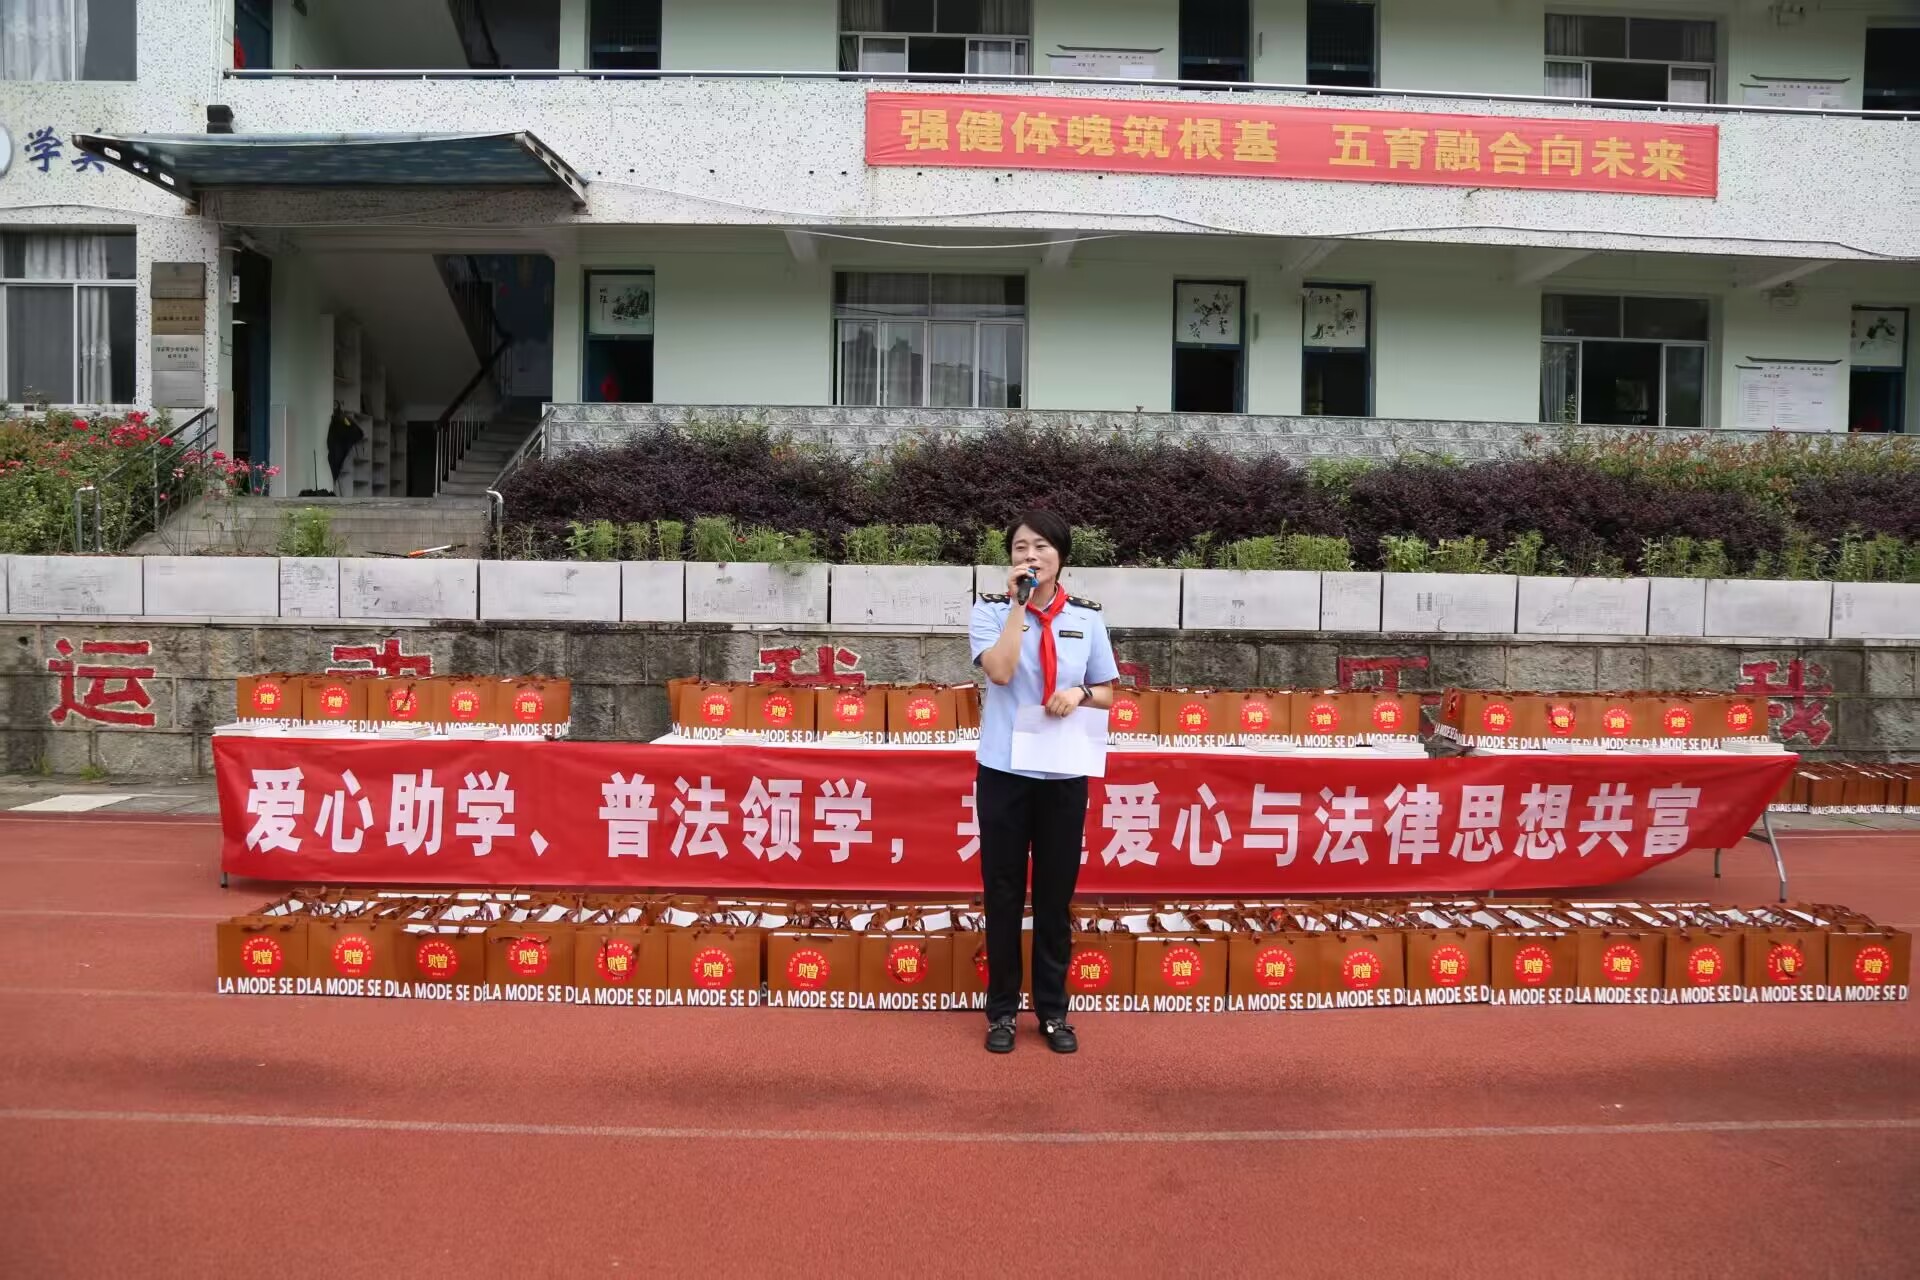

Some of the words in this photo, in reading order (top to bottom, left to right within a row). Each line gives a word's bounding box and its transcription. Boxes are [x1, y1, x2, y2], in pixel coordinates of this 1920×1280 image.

[900, 109, 1279, 163] 强健体魄筑根基
[1328, 124, 1687, 181] 五育融合向未来
[48, 638, 156, 728] 运
[511, 723, 539, 736] MODE
[541, 724, 553, 736] SE
[680, 726, 691, 739] LA
[693, 727, 723, 740] MODE
[791, 730, 803, 742] SE
[888, 732, 901, 744] LA
[903, 731, 933, 744] MODE
[935, 731, 946, 744] SE
[1159, 734, 1171, 747] LA
[1173, 734, 1203, 747] MODE
[1204, 735, 1216, 747] SE
[1225, 733, 1236, 746] LA
[1304, 735, 1332, 748] MODE
[1334, 735, 1345, 748] SE
[1463, 734, 1475, 747] LA
[1477, 735, 1505, 749] MODE
[1508, 737, 1519, 750] SE
[1528, 737, 1540, 750] LA
[1689, 738, 1699, 751] SE
[1708, 737, 1720, 750] LA
[252, 949, 272, 965] 赠
[343, 949, 363, 965] 赠
[428, 953, 448, 969] 赠
[518, 949, 539, 965] 赠
[607, 955, 628, 971] 赠
[897, 956, 918, 973] 赠
[1612, 956, 1632, 973] 赠
[703, 961, 724, 978] 赠
[797, 963, 818, 979] 赠
[1080, 963, 1101, 980] 赠
[1172, 960, 1193, 977] 赠
[1264, 961, 1285, 978] 赠
[1352, 962, 1372, 979] 赠
[1438, 959, 1459, 975] 赠
[1523, 958, 1544, 974] 赠
[1696, 959, 1715, 975] 赠
[1863, 958, 1882, 974] 赠
[218, 976, 234, 993] LA
[237, 977, 275, 994] MODE
[279, 977, 293, 994] SE
[306, 977, 322, 994] LA
[326, 978, 364, 996] MODE
[367, 979, 381, 996] SE
[395, 982, 411, 999] LA
[415, 982, 452, 1001] MODE
[456, 983, 470, 1001] SE
[486, 983, 501, 1001] LA
[505, 983, 544, 1001] MODE
[547, 984, 562, 1002] SE
[1743, 987, 1759, 1003] LA
[1761, 985, 1798, 1002] MODE
[1799, 984, 1813, 1001] SE
[1827, 984, 1842, 1001] LA
[1844, 984, 1881, 1002] MODE
[1882, 984, 1896, 1001] SE
[575, 987, 591, 1005] LA
[595, 987, 634, 1005] MODE
[637, 988, 652, 1006] SE
[667, 988, 683, 1006] LA
[687, 988, 727, 1006] MODE
[730, 989, 745, 1007] SE
[767, 989, 783, 1007] LA
[787, 990, 826, 1008] MODE
[830, 990, 845, 1008] SE
[858, 991, 875, 1009] LA
[879, 992, 919, 1010] MODE
[922, 992, 937, 1010] SE
[952, 991, 968, 1009] LA
[1105, 994, 1120, 1012] SE
[1133, 994, 1150, 1012] LA
[1153, 995, 1192, 1012] MODE
[1196, 995, 1211, 1012] SE
[1228, 993, 1245, 1011] LA
[1248, 993, 1287, 1010] MODE
[1289, 992, 1304, 1010] SE
[1318, 991, 1334, 1009] LA
[1336, 989, 1374, 1008] MODE
[1377, 988, 1392, 1006] SE
[1407, 989, 1422, 1006] LA
[1424, 986, 1462, 1005] MODE
[1464, 985, 1478, 1003] SE
[1490, 988, 1507, 1005] LA
[1509, 988, 1546, 1005] MODE
[1548, 987, 1563, 1004] SE
[1576, 986, 1592, 1003] LA
[1594, 986, 1631, 1004] MODE
[1634, 987, 1648, 1004] SE
[1664, 987, 1679, 1004] LA
[1680, 986, 1715, 1004] MODE
[1717, 985, 1731, 1002] SE
